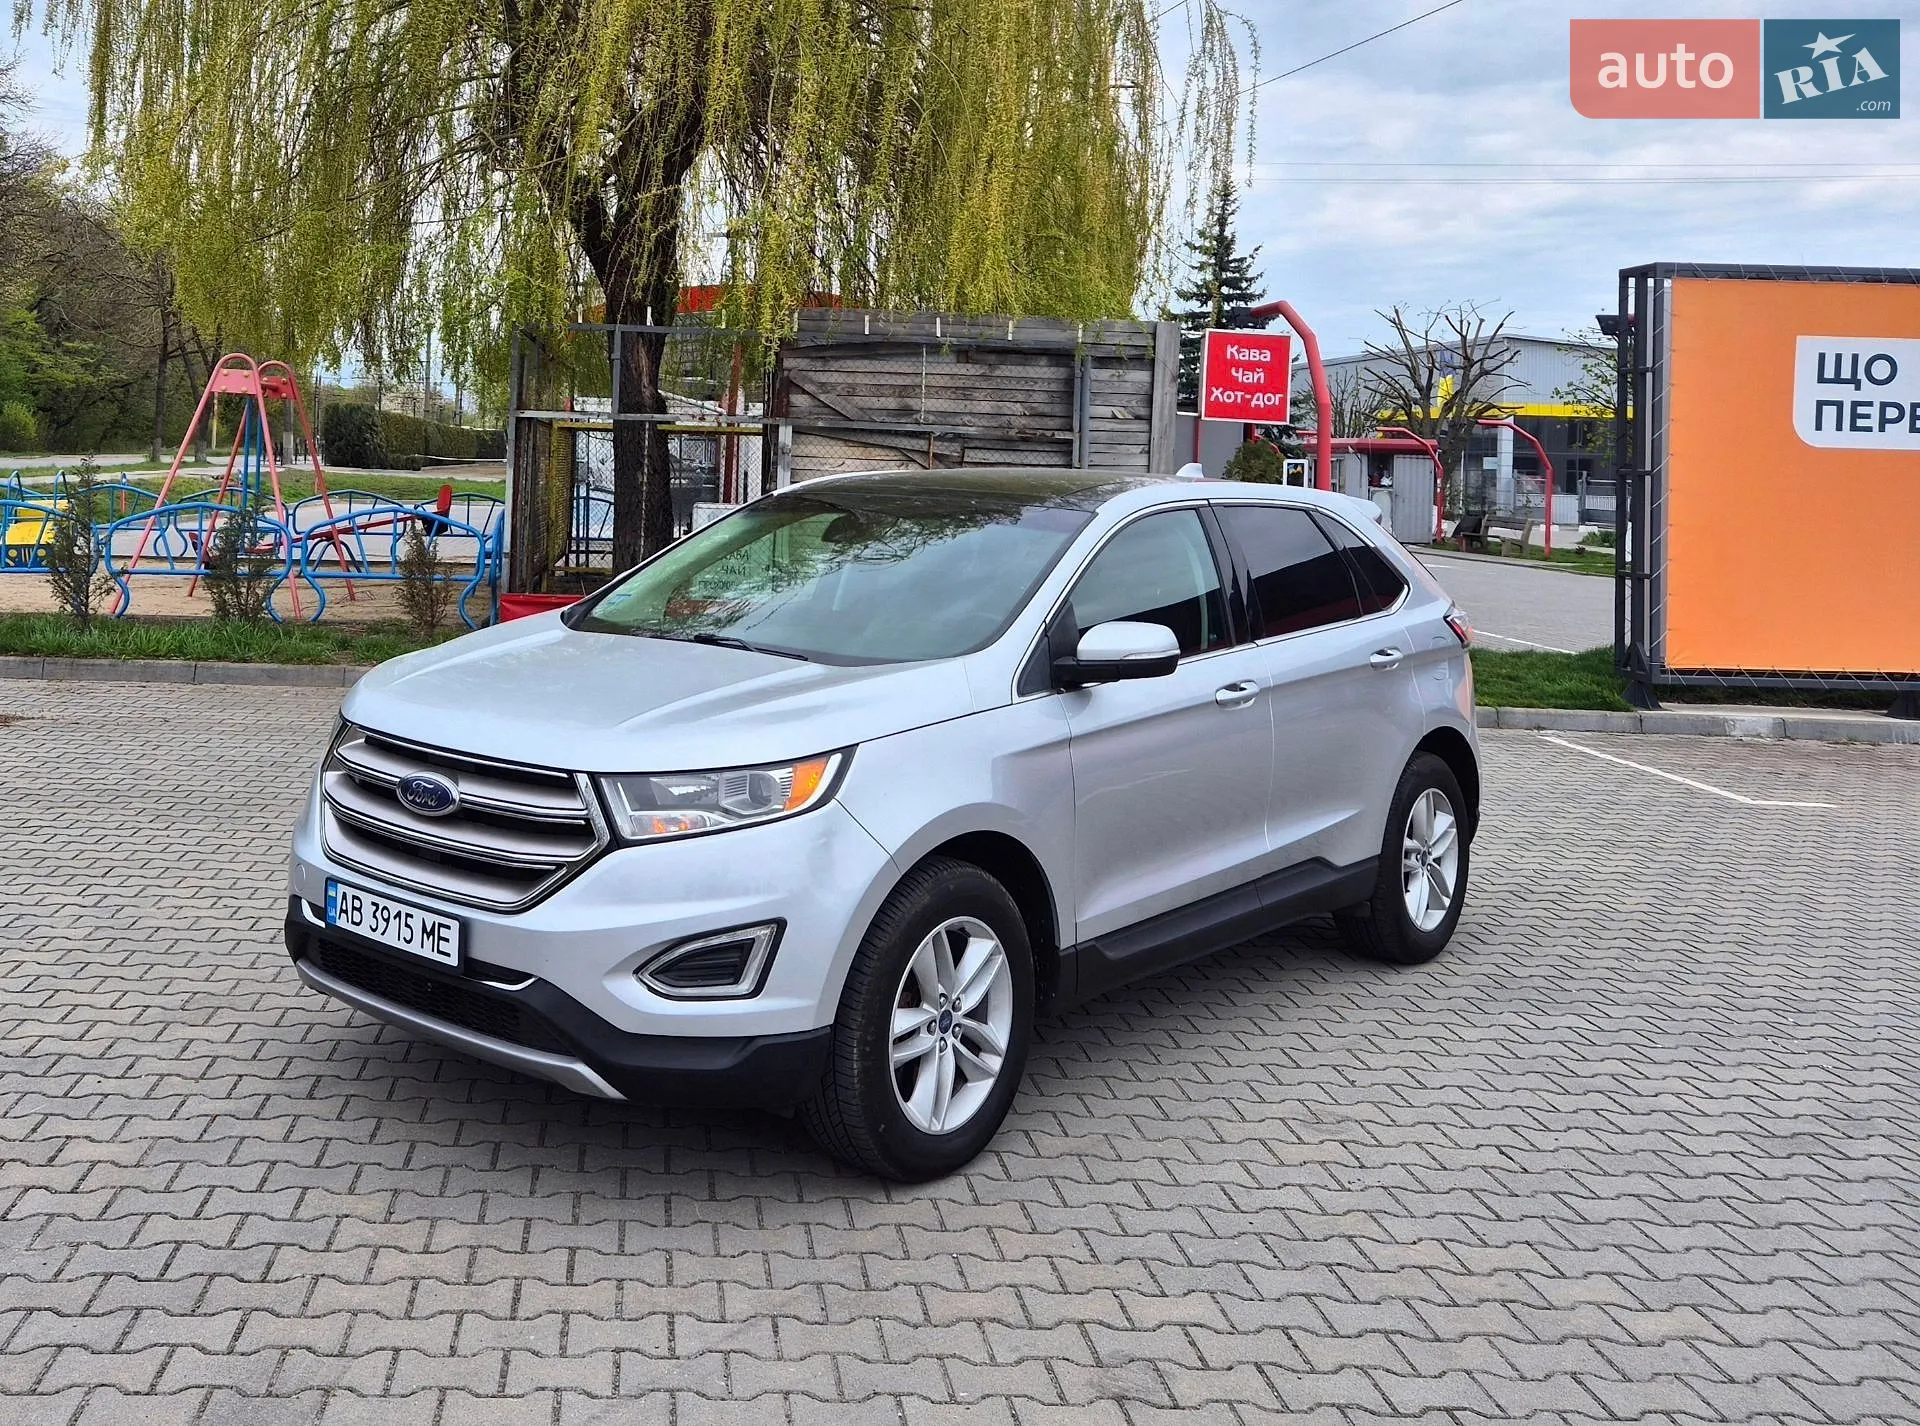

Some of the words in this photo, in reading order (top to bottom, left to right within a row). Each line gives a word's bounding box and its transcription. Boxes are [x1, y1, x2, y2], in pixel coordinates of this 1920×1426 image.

[1226, 344, 1271, 362] Кава
[1231, 366, 1265, 384] Чай
[1816, 351, 1898, 391] ЩО
[1210, 386, 1284, 408] Хот-дог
[406, 780, 440, 807] Ford
[338, 891, 363, 927] AB
[369, 901, 414, 945] 3915
[420, 917, 452, 958] ME
